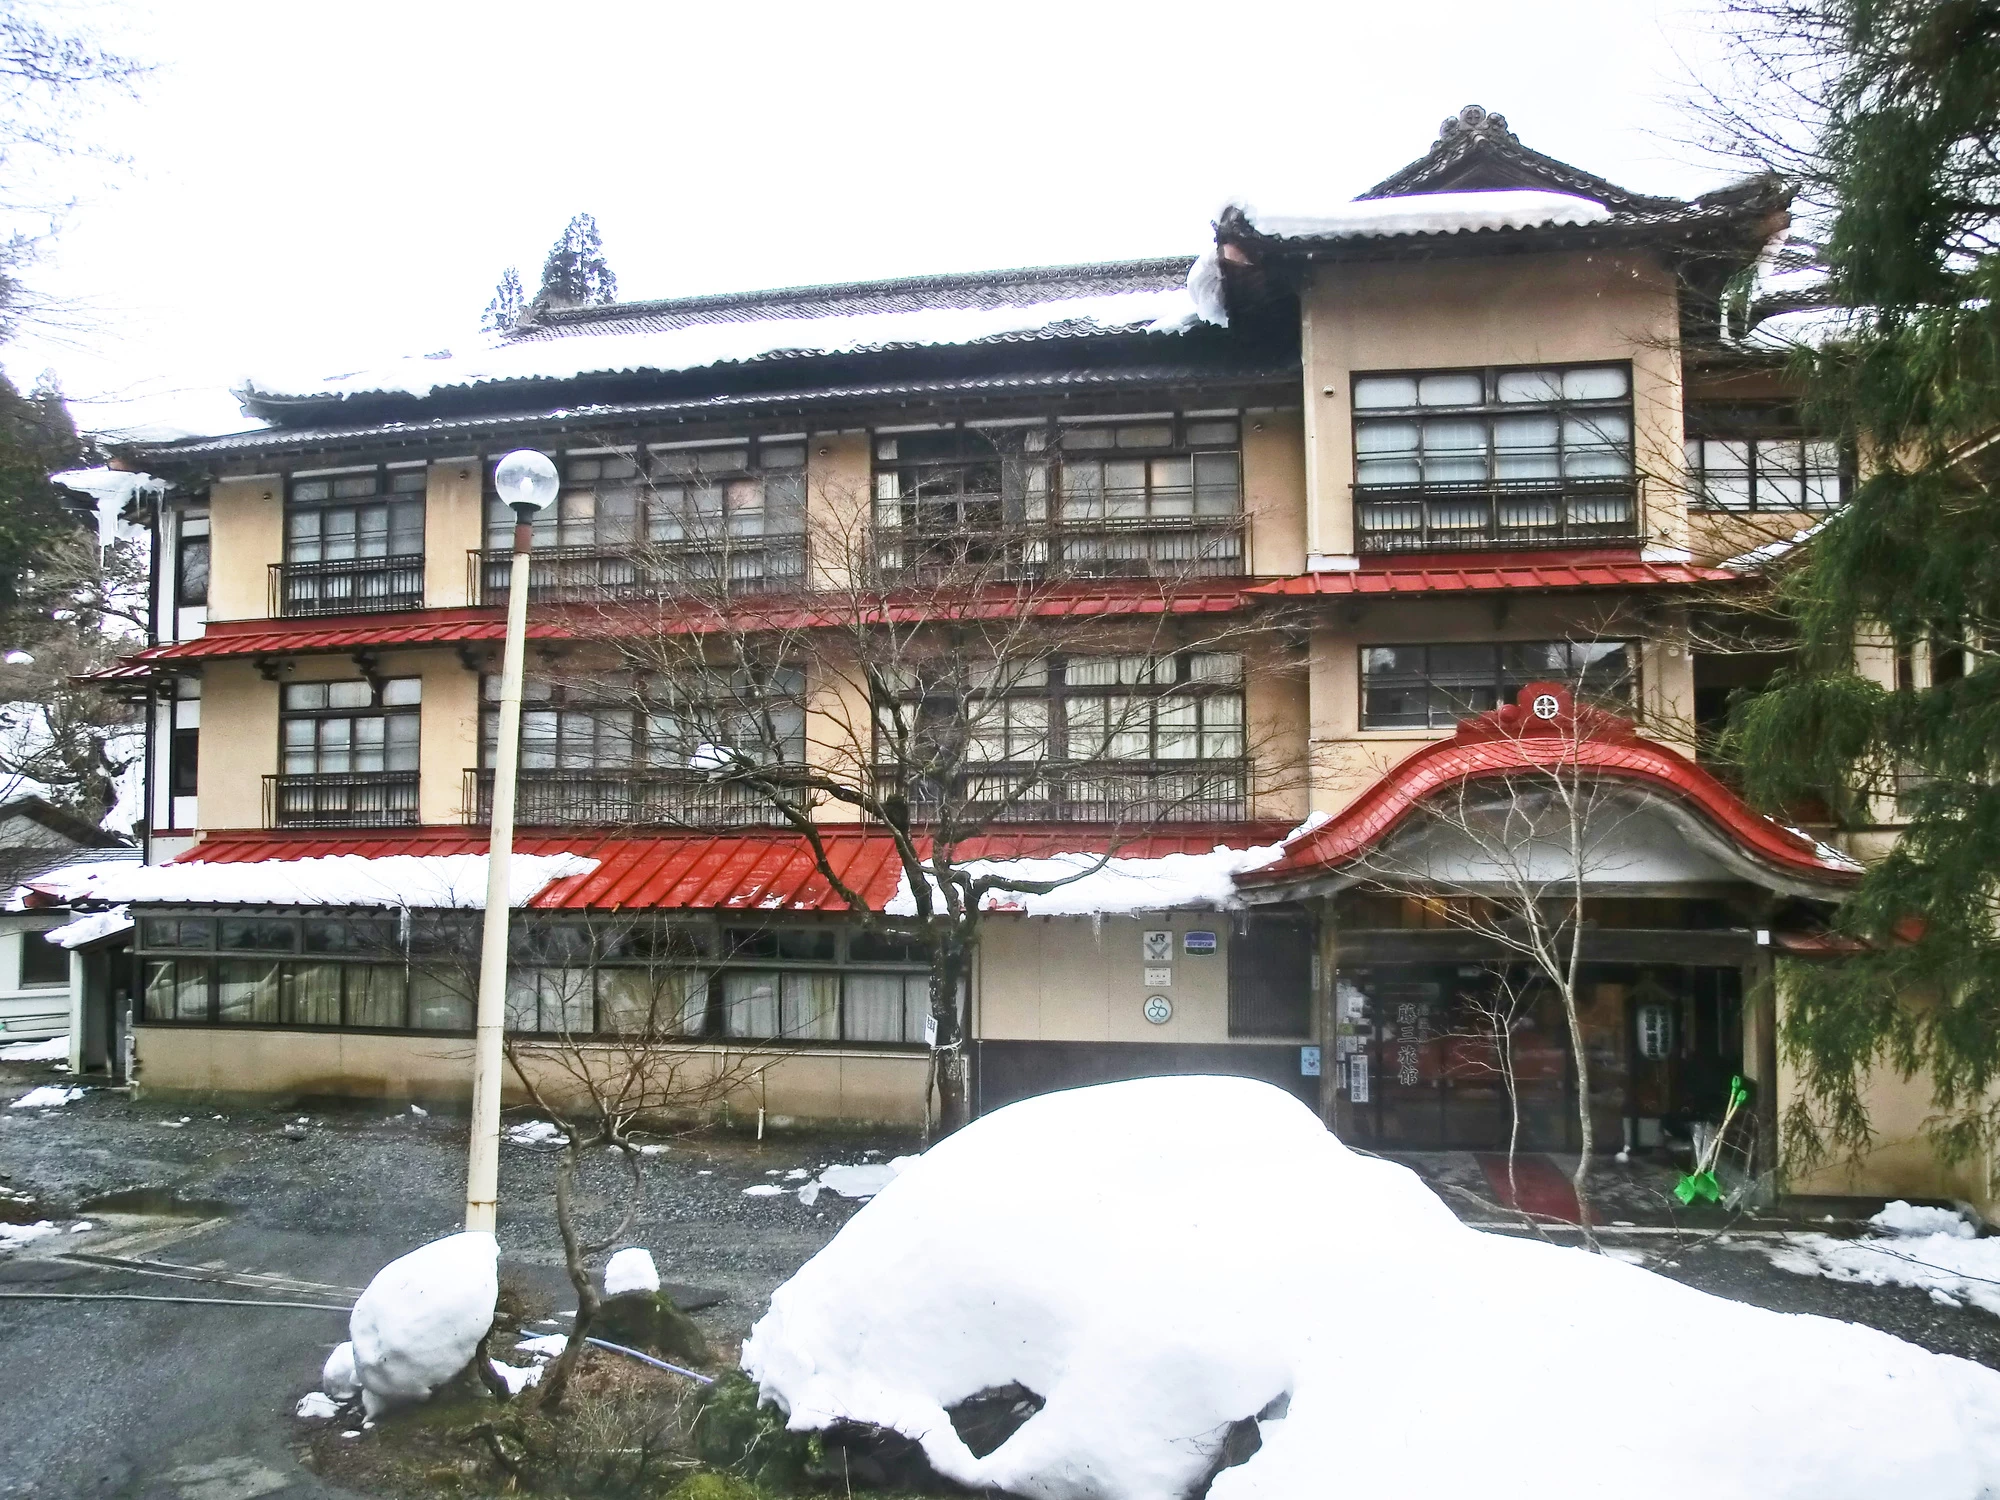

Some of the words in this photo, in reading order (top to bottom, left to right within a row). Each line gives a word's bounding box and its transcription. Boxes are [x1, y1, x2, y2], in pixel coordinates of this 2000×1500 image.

[1150, 933, 1165, 942] JR
[1397, 1003, 1419, 1085] 藤三旅館
